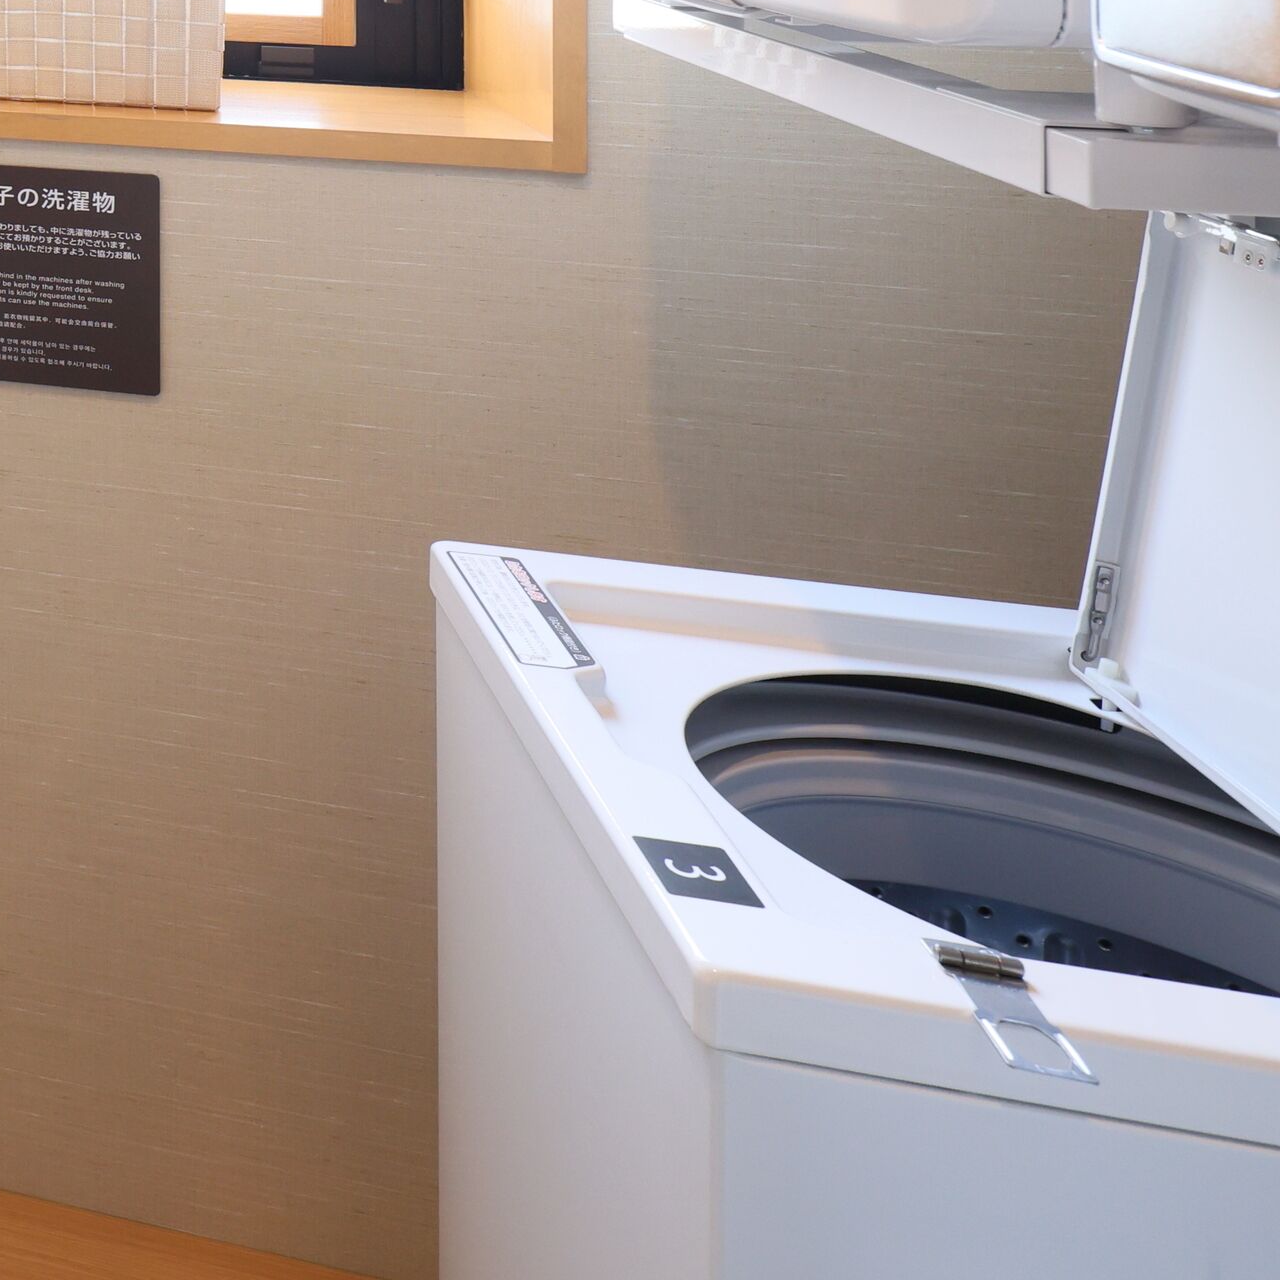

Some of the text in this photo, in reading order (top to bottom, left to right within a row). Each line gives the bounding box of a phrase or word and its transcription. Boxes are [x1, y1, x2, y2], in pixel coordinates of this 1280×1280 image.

[13, 281, 30, 290] kept
[31, 282, 40, 290] by
[74, 286, 94, 294] desk.
[38, 276, 74, 284] machines
[94, 280, 125, 289] washing
[16, 290, 38, 298] kindly
[39, 292, 76, 300] requested
[51, 301, 89, 310] machines.
[662, 857, 727, 884] 3
